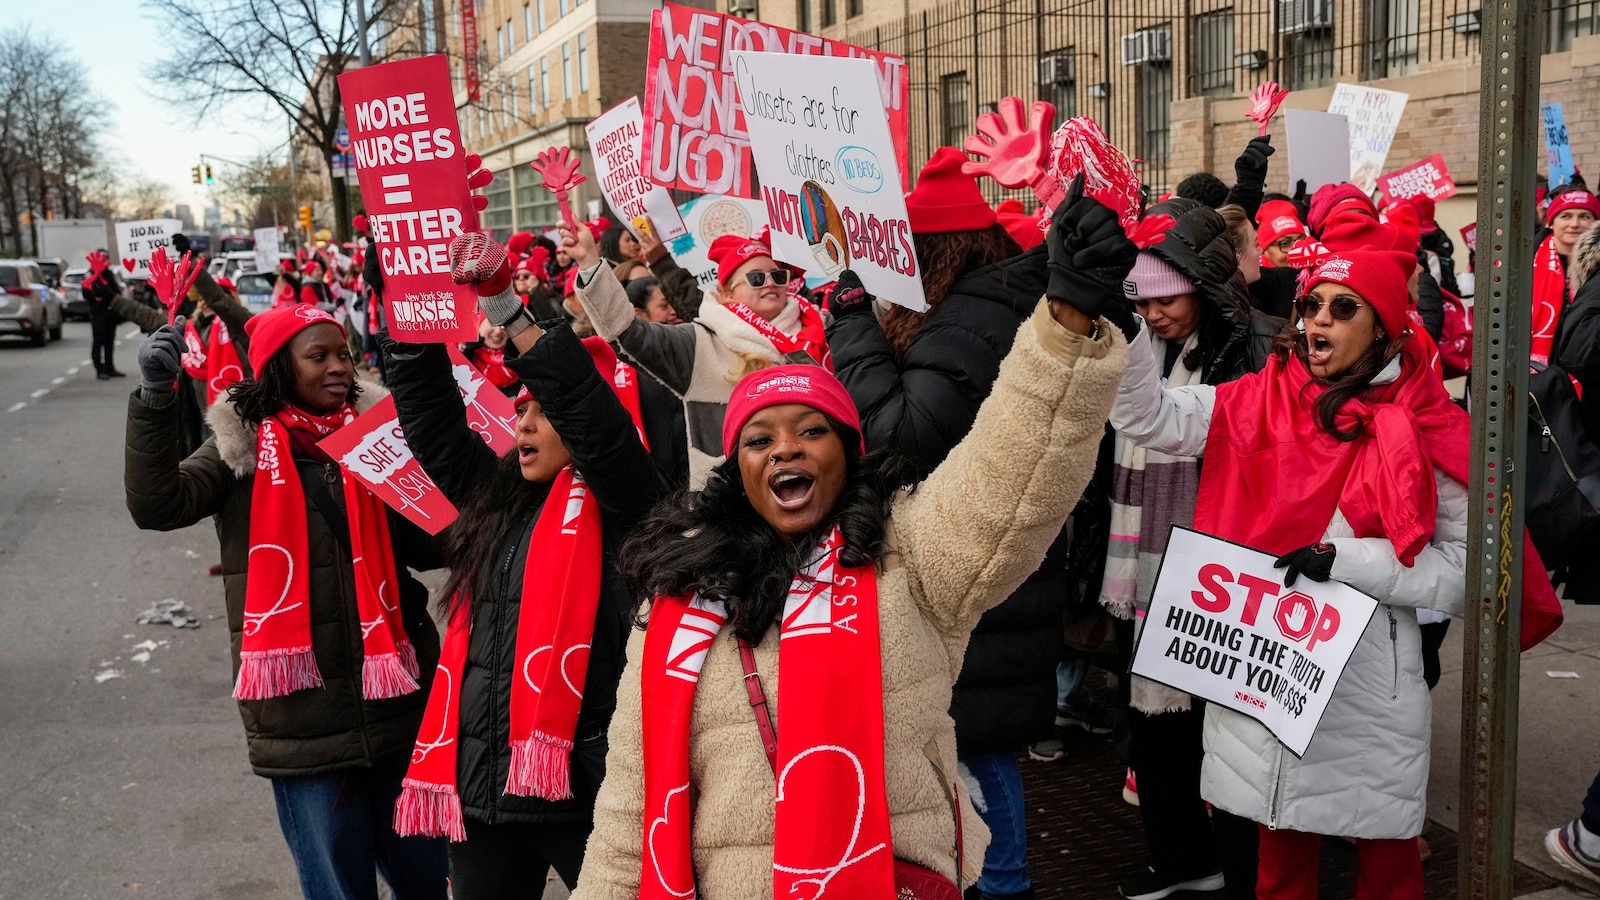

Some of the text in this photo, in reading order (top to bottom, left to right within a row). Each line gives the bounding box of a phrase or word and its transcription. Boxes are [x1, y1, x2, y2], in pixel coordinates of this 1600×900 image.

[662, 6, 721, 70] WE
[736, 55, 860, 135] Closets are for
[354, 92, 429, 133] MORE
[353, 127, 456, 169] NURSES
[595, 120, 640, 158] HOSPITAL
[842, 158, 881, 180] NO BEDS
[1387, 162, 1434, 187] NURSES
[1389, 169, 1442, 198] DESERVE
[610, 176, 653, 208] MAKE US
[369, 208, 465, 243] BETTER
[623, 197, 648, 222] SICK
[764, 185, 804, 240] NOT
[129, 238, 170, 252] IF YOU
[130, 225, 165, 238] HONK
[842, 206, 916, 278] BABIES
[381, 243, 451, 277] CARE
[692, 268, 718, 286] THIS
[392, 299, 457, 323] NURSES
[405, 290, 454, 302] New York State
[396, 320, 459, 331] ASSOCIATION
[359, 436, 403, 474] SAFE
[1190, 563, 1341, 652] STOP
[1165, 605, 1326, 694] HIDING THE TRUTH
[1165, 636, 1242, 680] ABOUT
[1246, 662, 1288, 704] YOUR
